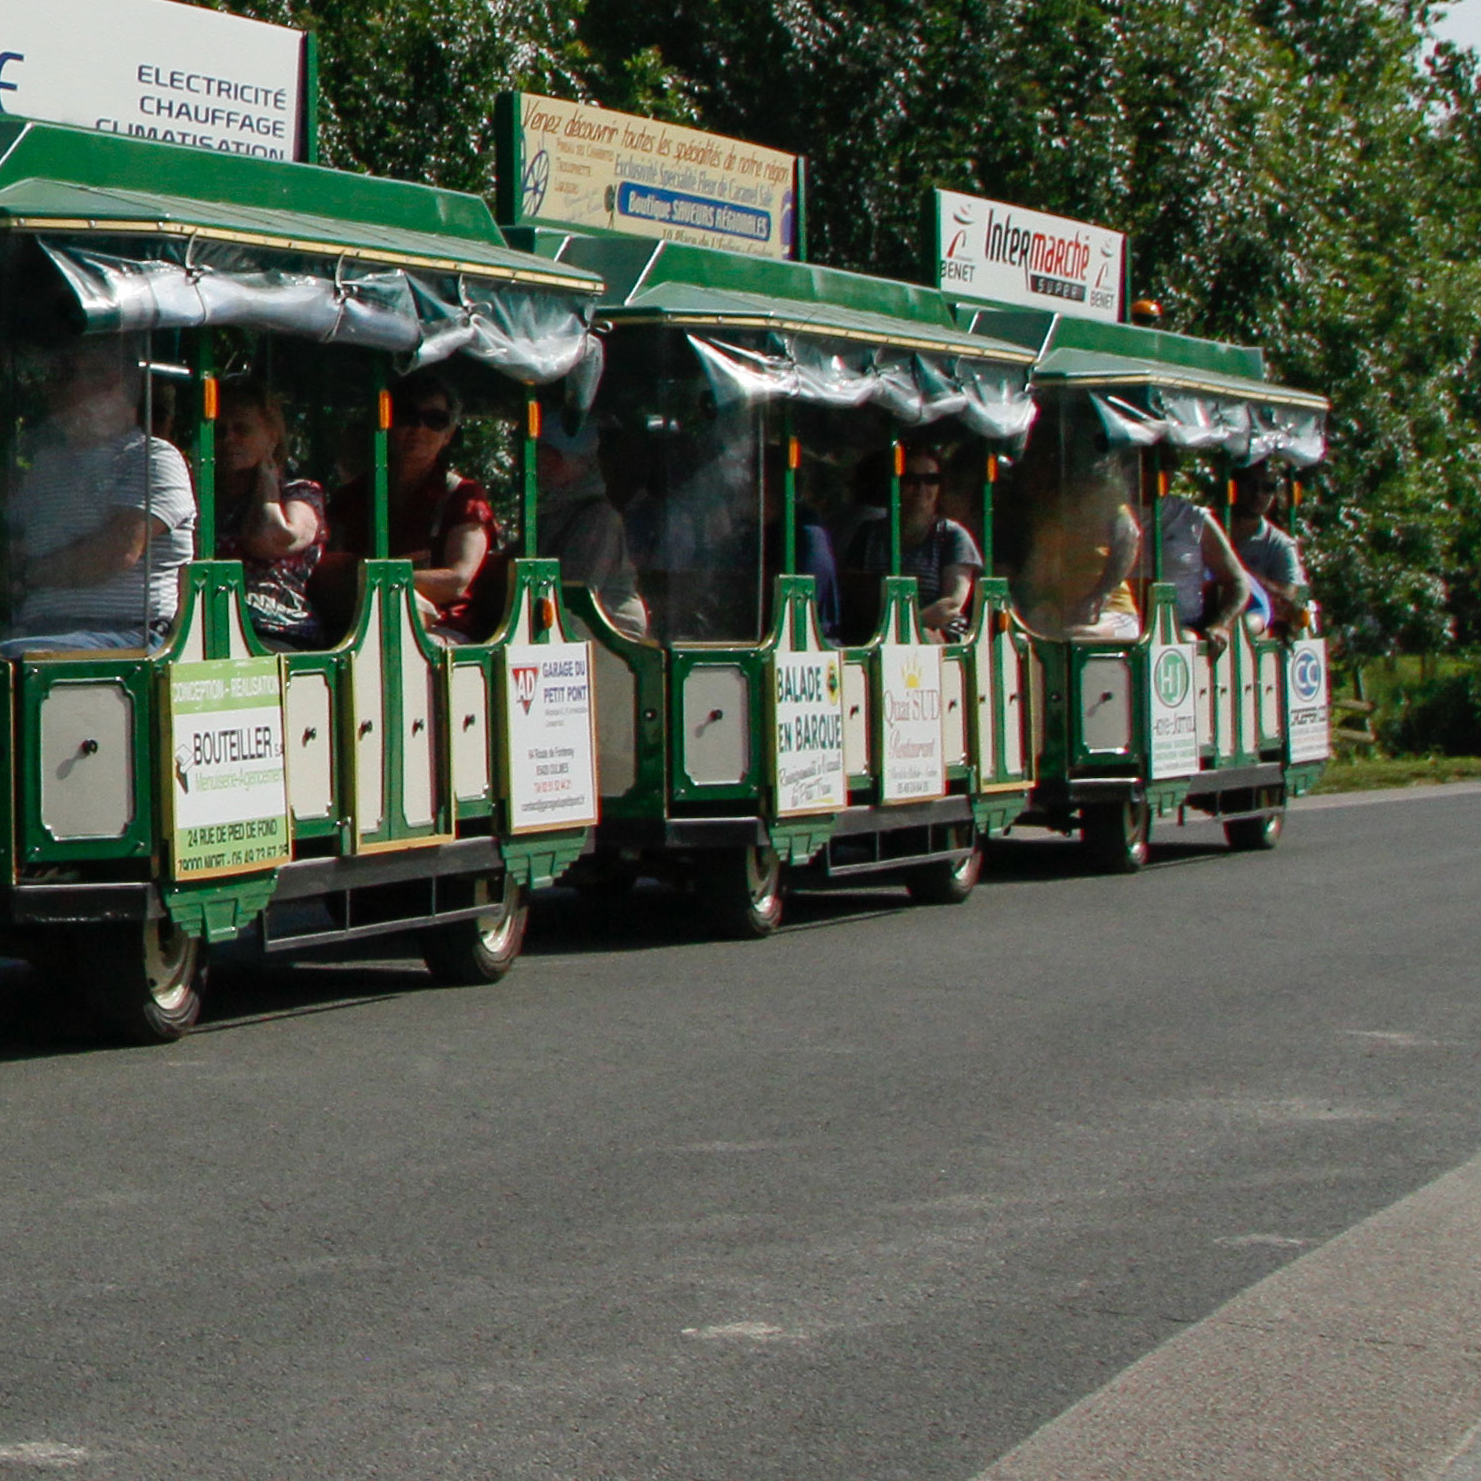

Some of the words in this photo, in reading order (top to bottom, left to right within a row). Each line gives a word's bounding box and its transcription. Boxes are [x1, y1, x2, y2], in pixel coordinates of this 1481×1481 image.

[137, 63, 287, 111] ELECTRICITÉ
[139, 94, 286, 140] CHAUFFAGE
[523, 99, 563, 135] Venez
[564, 108, 619, 144] découvrir
[621, 121, 656, 153] toutes
[656, 128, 673, 157] les
[673, 138, 723, 168] spécialités
[724, 143, 737, 171] de
[739, 152, 763, 178] notre
[985, 207, 1090, 286] Intermarché
[940, 259, 976, 283] BENET
[1090, 290, 1115, 310] BENET
[517, 669, 536, 702] AD
[542, 661, 574, 678] GARAGE
[575, 660, 586, 676] DU
[776, 666, 822, 704] BALADE
[543, 686, 566, 704] PETIT
[567, 685, 587, 702] PONT
[912, 689, 940, 722] SUD
[193, 726, 272, 765] BOUTEILLER
[778, 722, 792, 754] EN
[795, 713, 842, 752] BARQUE
[199, 827, 215, 846] RUE
[216, 825, 226, 843] DE
[227, 822, 244, 842] PIED
[245, 820, 256, 839] DE
[257, 818, 277, 837] FOND
